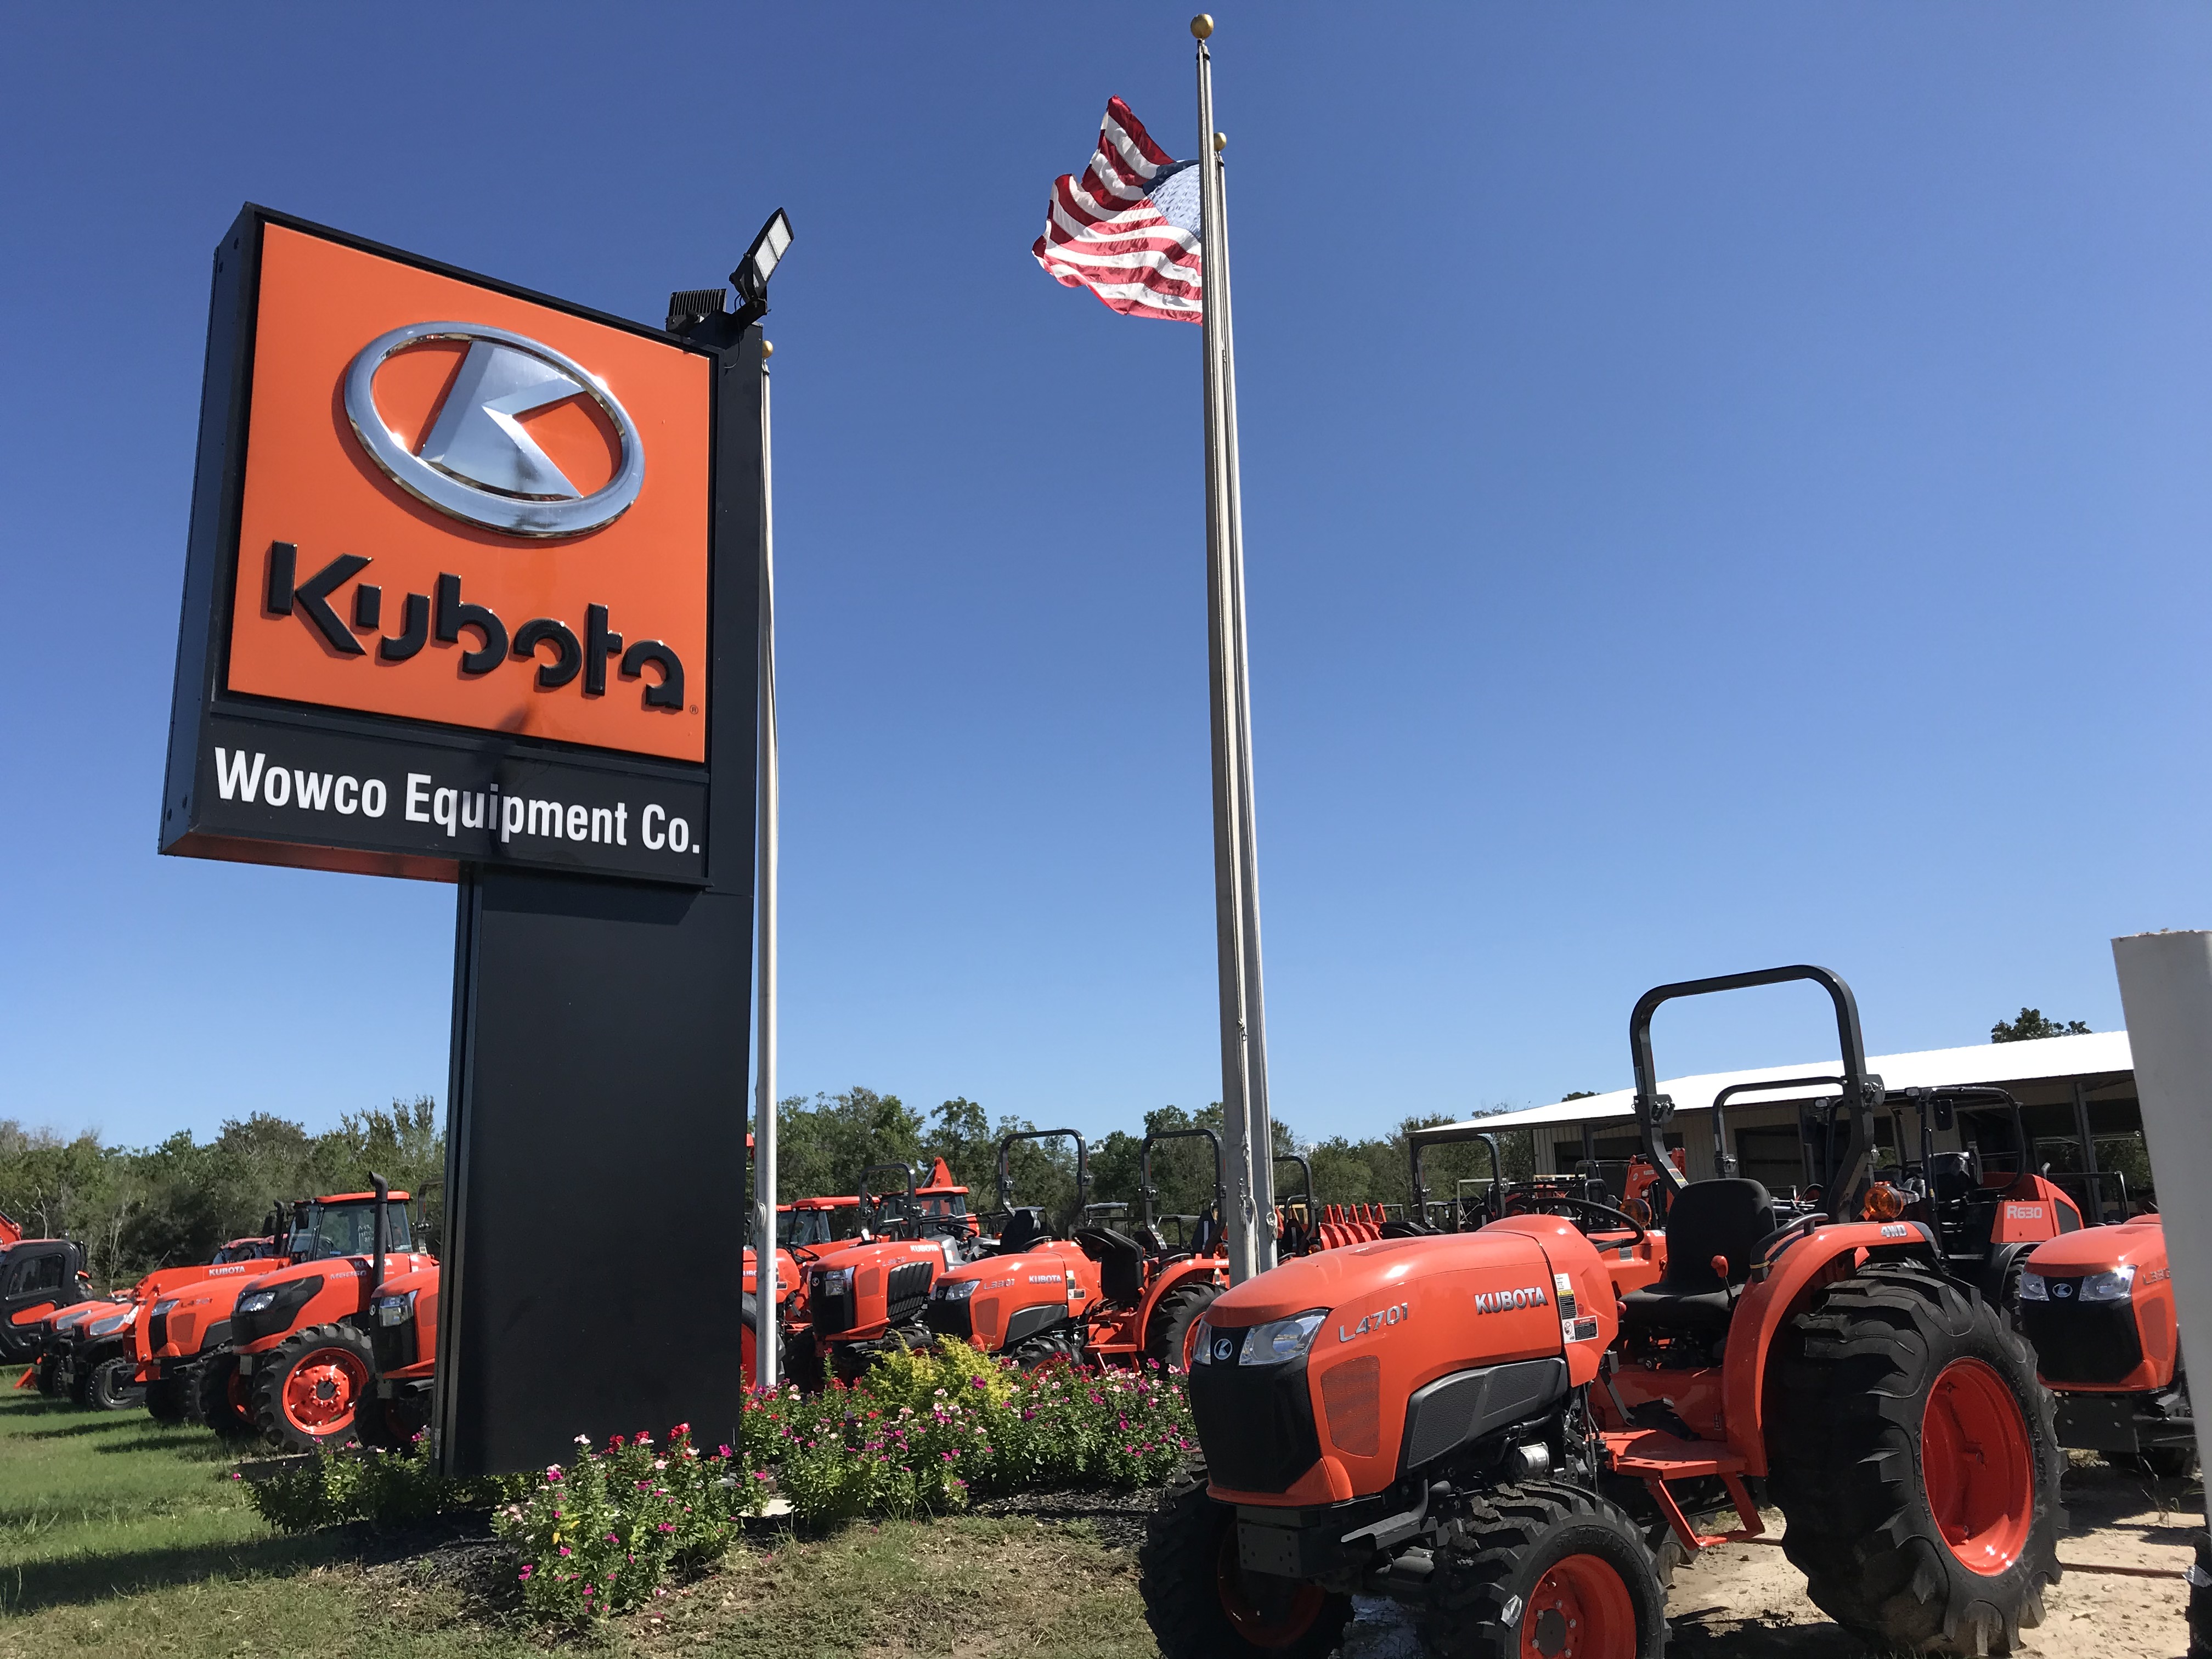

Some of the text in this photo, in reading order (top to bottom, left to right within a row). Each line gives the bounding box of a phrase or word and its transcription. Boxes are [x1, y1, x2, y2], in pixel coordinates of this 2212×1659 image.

[214, 746, 701, 854] Wowco Equipment Co.
[2006, 1205, 2042, 1219] R630
[1880, 1224, 1908, 1238] 4WD
[910, 1244, 940, 1252] KUBOTA
[208, 1266, 246, 1277] KUBOTA
[983, 1278, 1015, 1290] L3301
[1028, 1274, 1062, 1284] KUBOTA
[1475, 1286, 1548, 1316] KUBOTA
[1339, 1302, 1409, 1343] L4701
